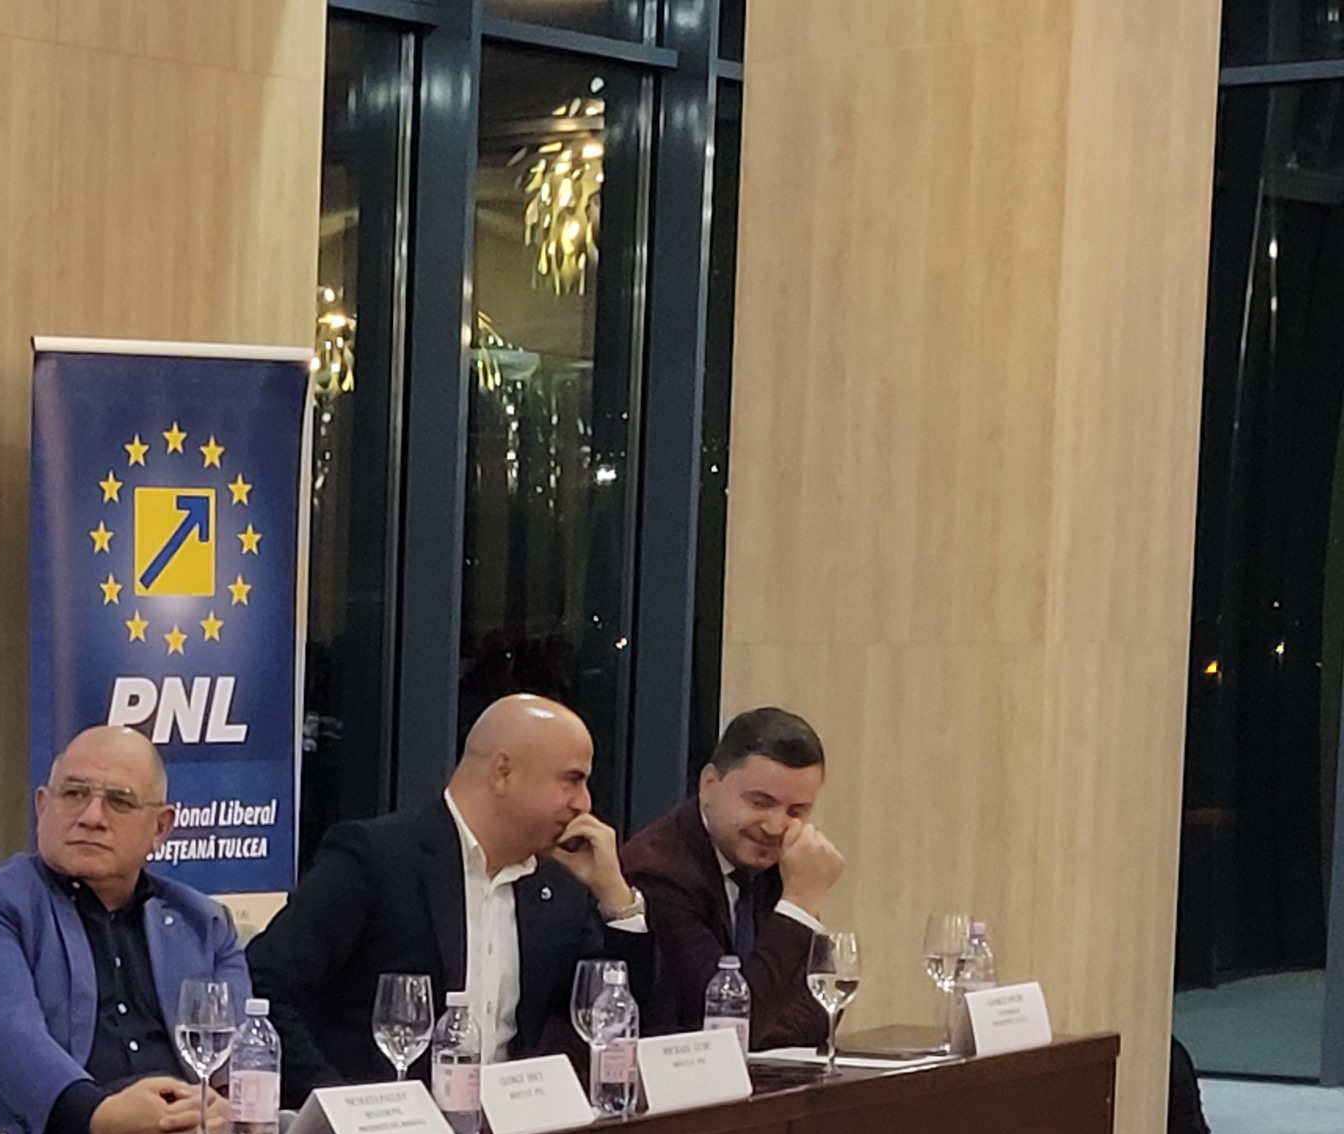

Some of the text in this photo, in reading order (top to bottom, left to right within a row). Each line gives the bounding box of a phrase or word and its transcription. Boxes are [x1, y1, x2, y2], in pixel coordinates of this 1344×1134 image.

[108, 676, 248, 744] PNL
[172, 798, 277, 828] ional Liberal
[217, 837, 268, 859] TULCEA
